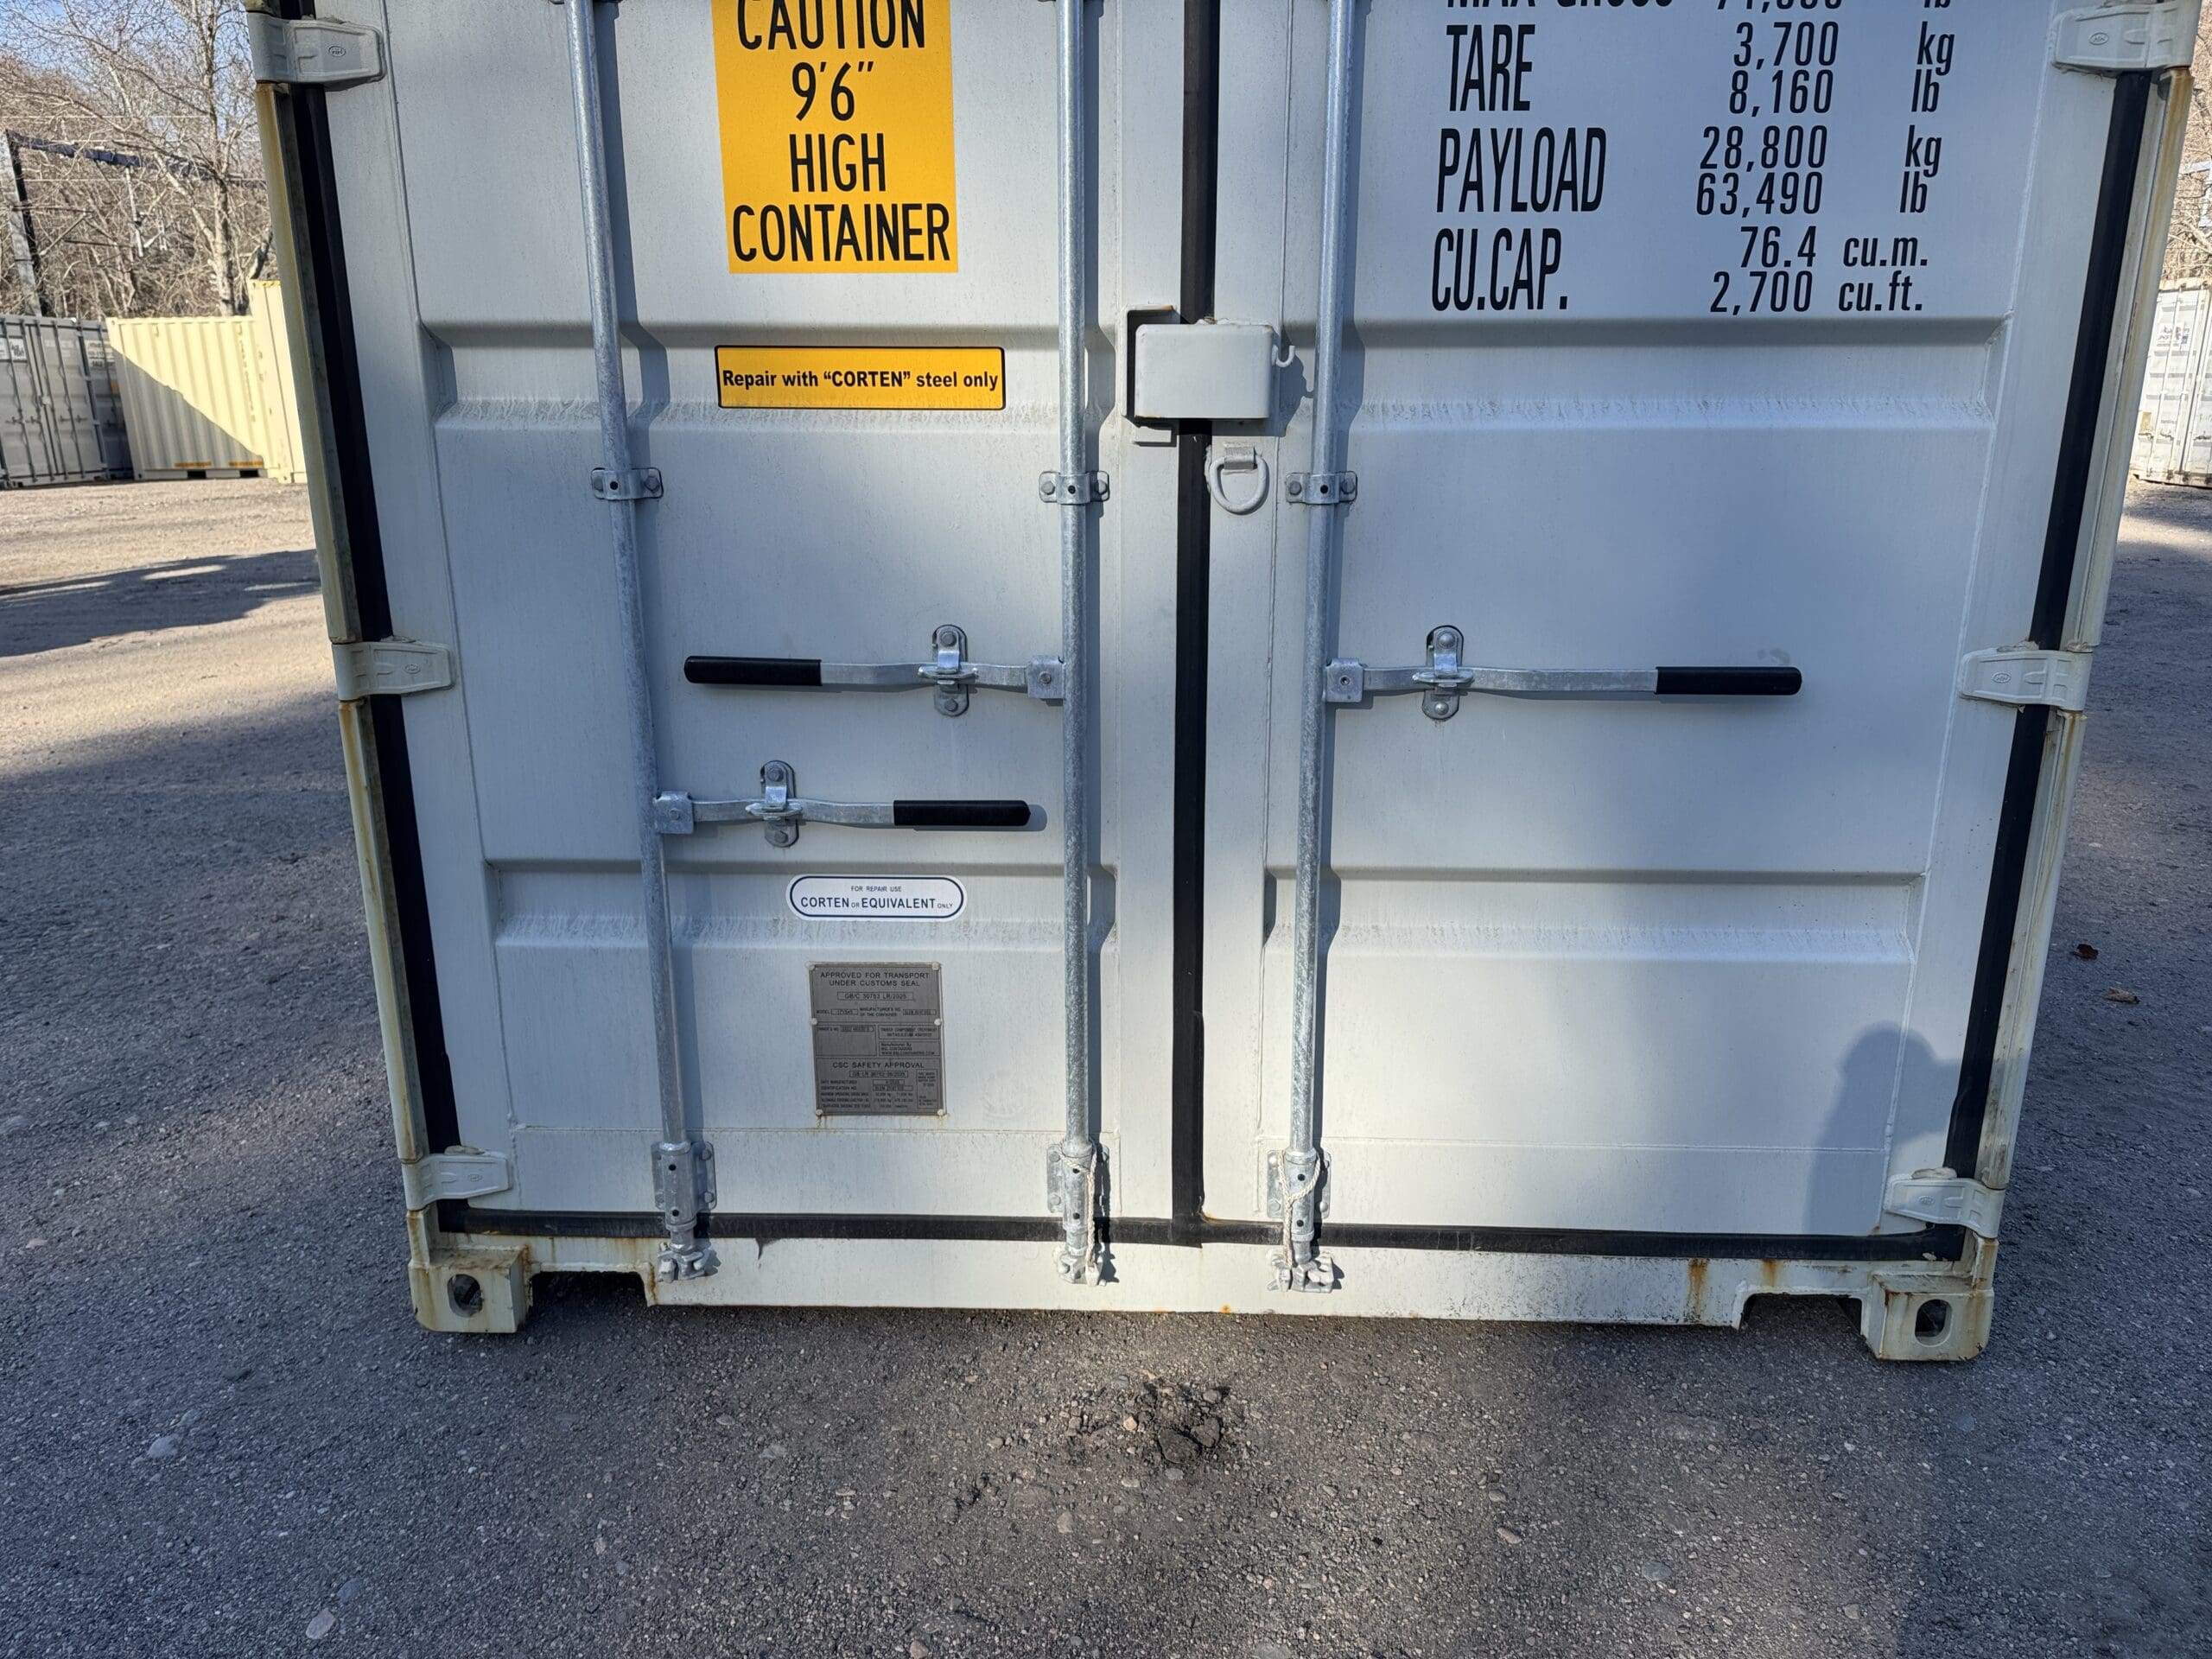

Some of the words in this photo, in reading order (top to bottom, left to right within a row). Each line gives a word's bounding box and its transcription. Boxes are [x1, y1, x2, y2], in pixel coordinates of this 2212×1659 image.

[737, 0, 925, 50] CAUTION
[1446, 24, 1535, 111] TARE
[1733, 21, 1839, 70] 3,700
[1916, 21, 1955, 76] kg
[1729, 69, 1834, 118] 8,160
[1910, 69, 1940, 112] lb
[789, 133, 886, 192] HIGH
[1436, 127, 1606, 213] PAYLOAD
[1700, 124, 1827, 173] 28,800
[1904, 124, 1942, 178] kg
[1696, 171, 1823, 218] 63,490
[1899, 171, 1928, 213] lb
[733, 203, 950, 262] CONTAINER
[1431, 227, 1567, 311] CU.CAP.
[1740, 226, 1816, 268] 76.4
[1842, 236, 1928, 267] cu.m.
[1710, 270, 1813, 315] 2,700
[1838, 270, 1923, 312] cu.ft.
[722, 369, 777, 390] Repair
[781, 370, 818, 387] with
[916, 371, 957, 388] steel
[963, 371, 998, 391] only
[800, 897, 849, 908] CORTEN
[861, 898, 936, 909] EQUIVALENT
